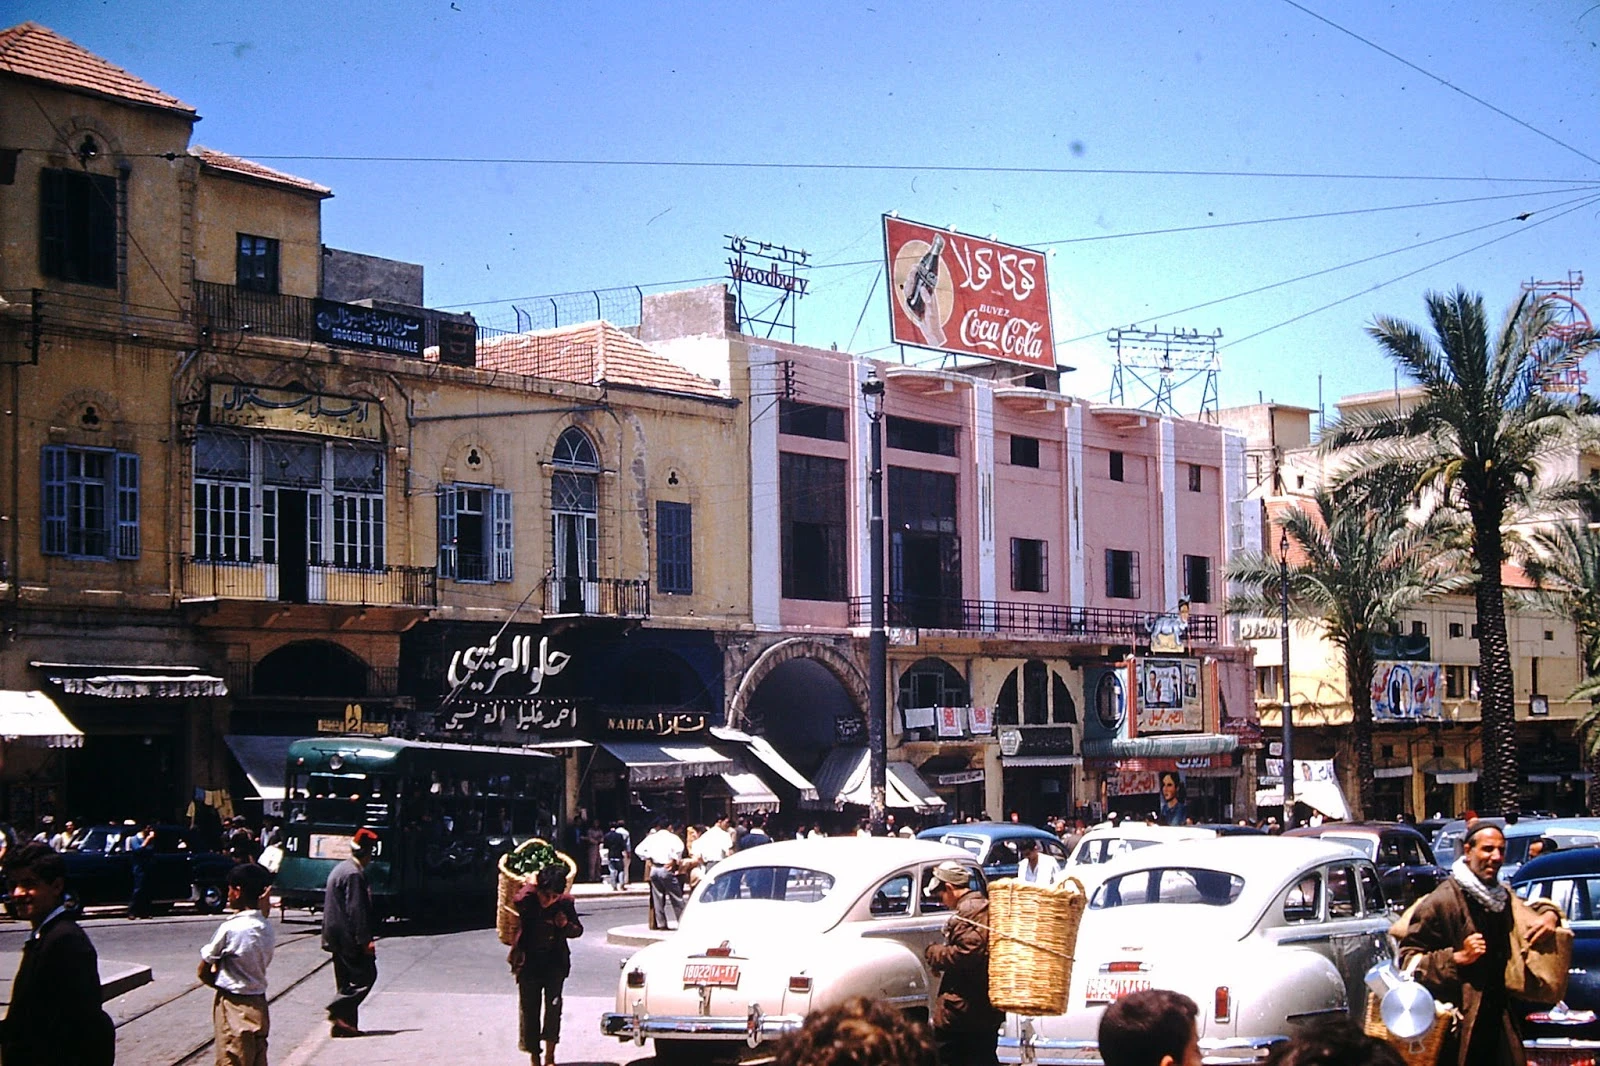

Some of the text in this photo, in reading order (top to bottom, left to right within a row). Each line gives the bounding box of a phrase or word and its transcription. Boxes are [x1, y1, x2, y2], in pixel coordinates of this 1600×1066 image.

[950, 237, 993, 291] كولا
[727, 256, 810, 300] Woodbury
[979, 303, 1010, 317] BUVEZ
[331, 327, 418, 353] DROGUERIE NATIONALE
[211, 406, 279, 428] HOTEL
[527, 635, 571, 695] حلو
[348, 718, 358, 731] 2
[516, 702, 544, 730] خليل
[542, 706, 577, 729] احمد
[607, 718, 654, 731] NAHRA
[286, 837, 299, 852] 41
[684, 965, 709, 979] 18022
